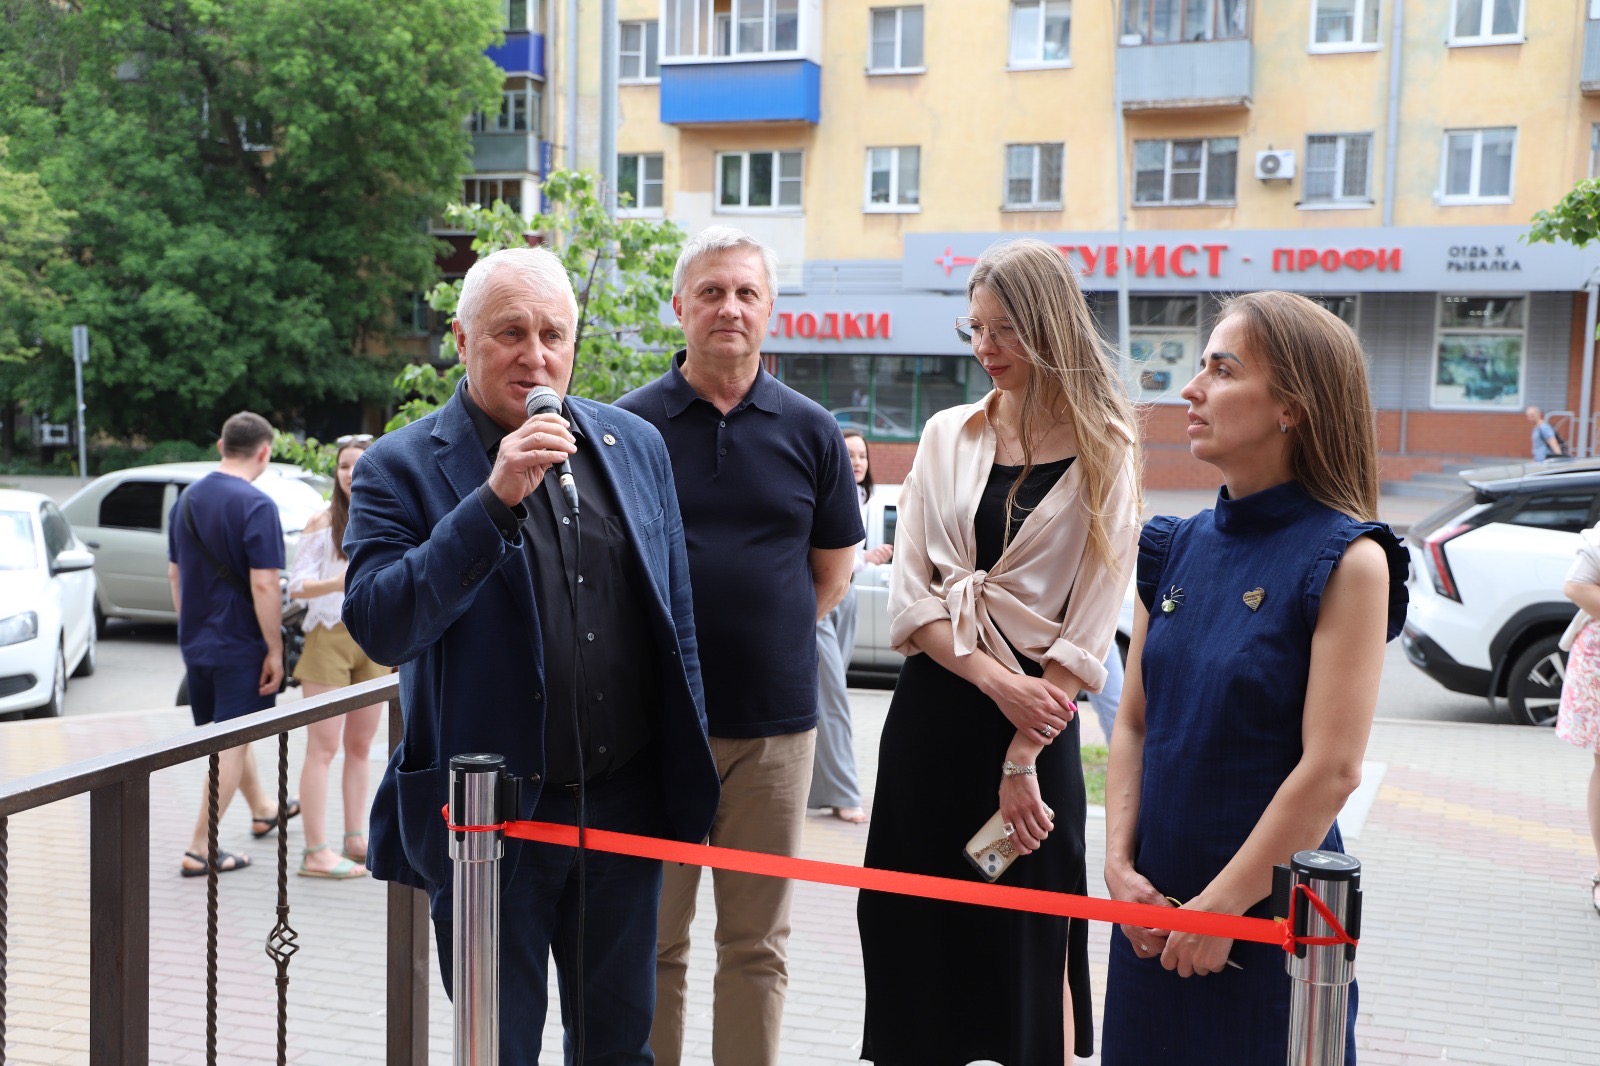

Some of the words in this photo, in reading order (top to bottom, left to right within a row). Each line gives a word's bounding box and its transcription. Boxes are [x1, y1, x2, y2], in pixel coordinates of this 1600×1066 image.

[1272, 248, 1402, 272] ПРОФИ
[1447, 260, 1522, 272] РЫБАЛКА
[770, 312, 890, 341] ЛОДКИ
